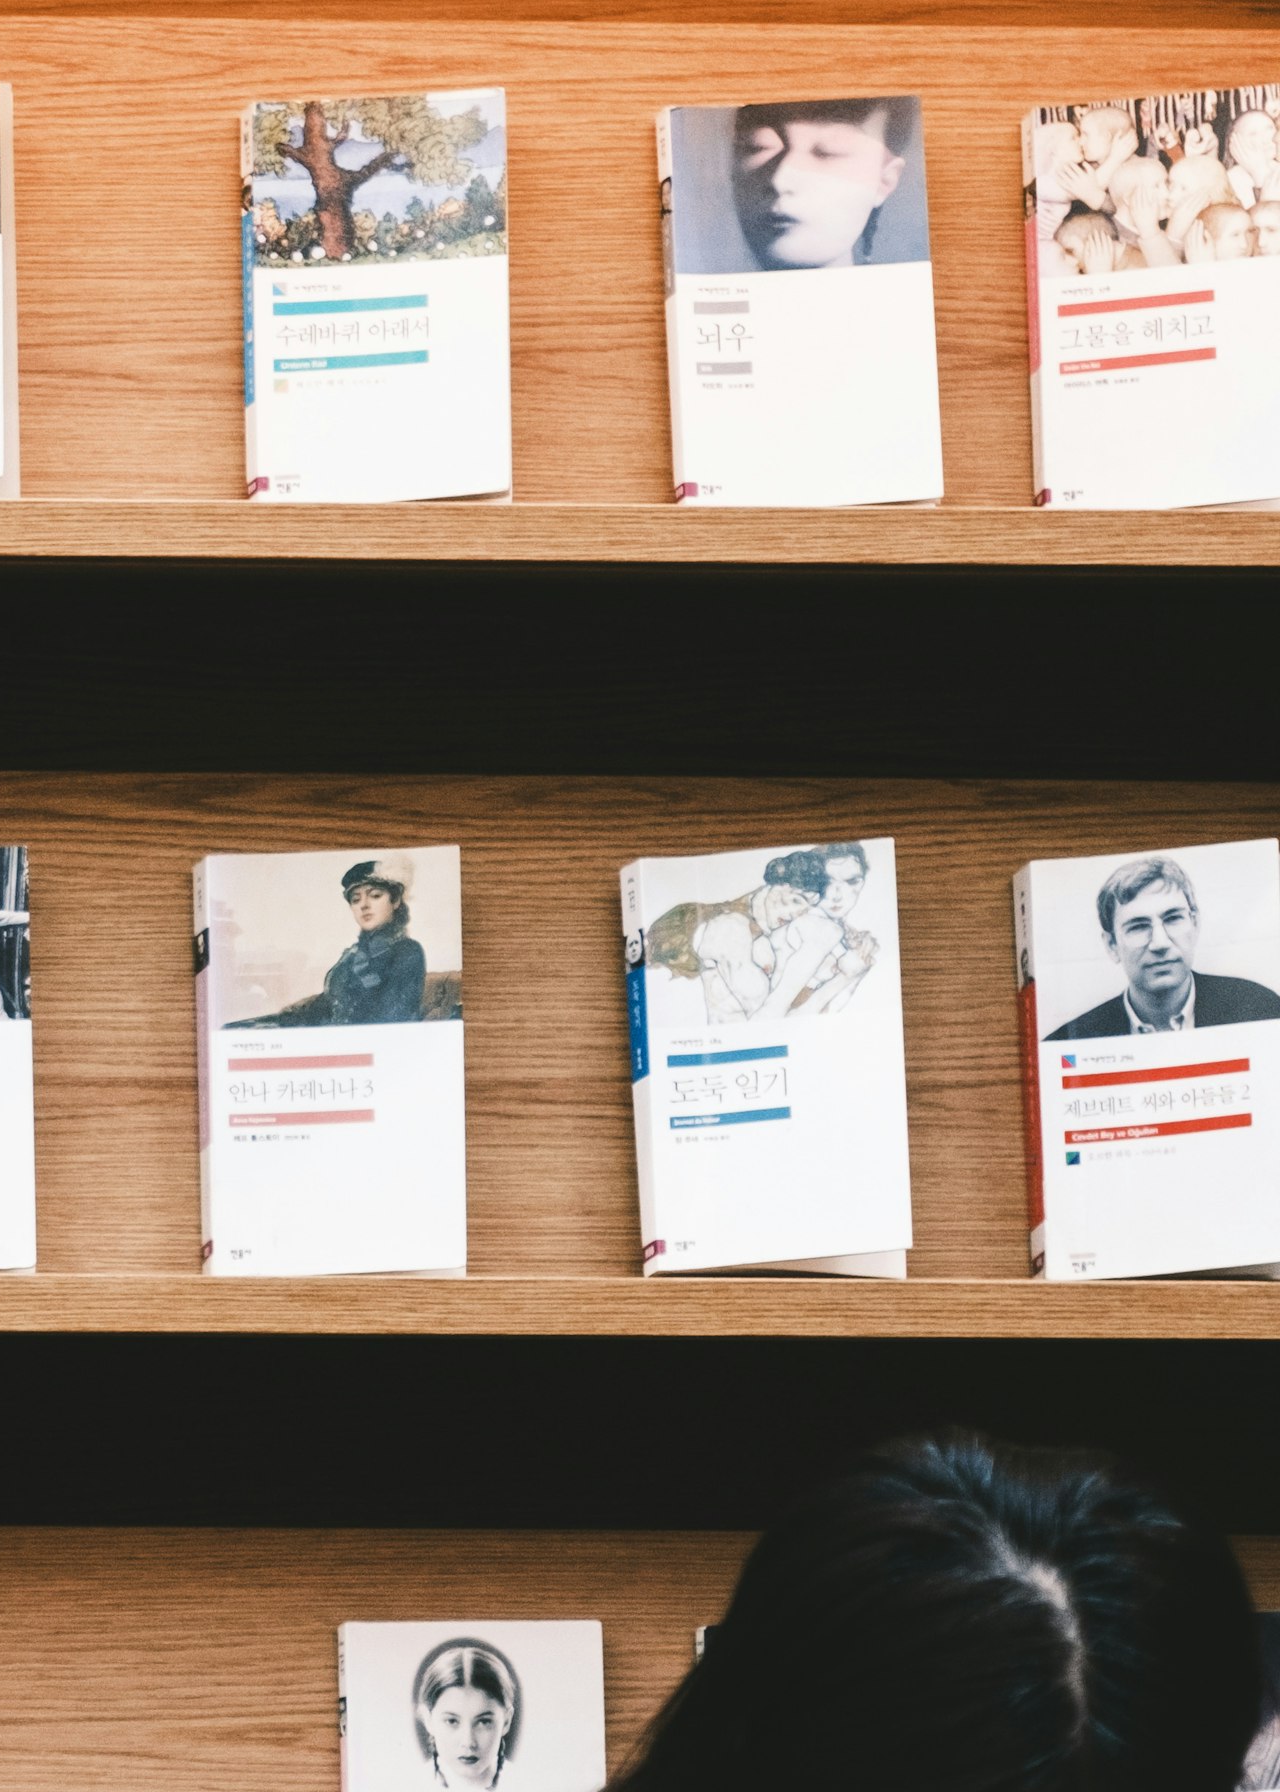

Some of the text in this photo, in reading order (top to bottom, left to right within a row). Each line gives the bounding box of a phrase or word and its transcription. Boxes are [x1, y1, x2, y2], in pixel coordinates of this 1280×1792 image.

[276, 315, 430, 347] 수레바퀴 아래서
[697, 322, 754, 353] 뇌우
[1059, 314, 1214, 351] 그물을 헤치고
[228, 1077, 375, 1103] 안나 카레니나 3
[665, 1062, 788, 1104] 도둑 일기
[1064, 1083, 1251, 1118] 제브데트 씨와 아들들 2
